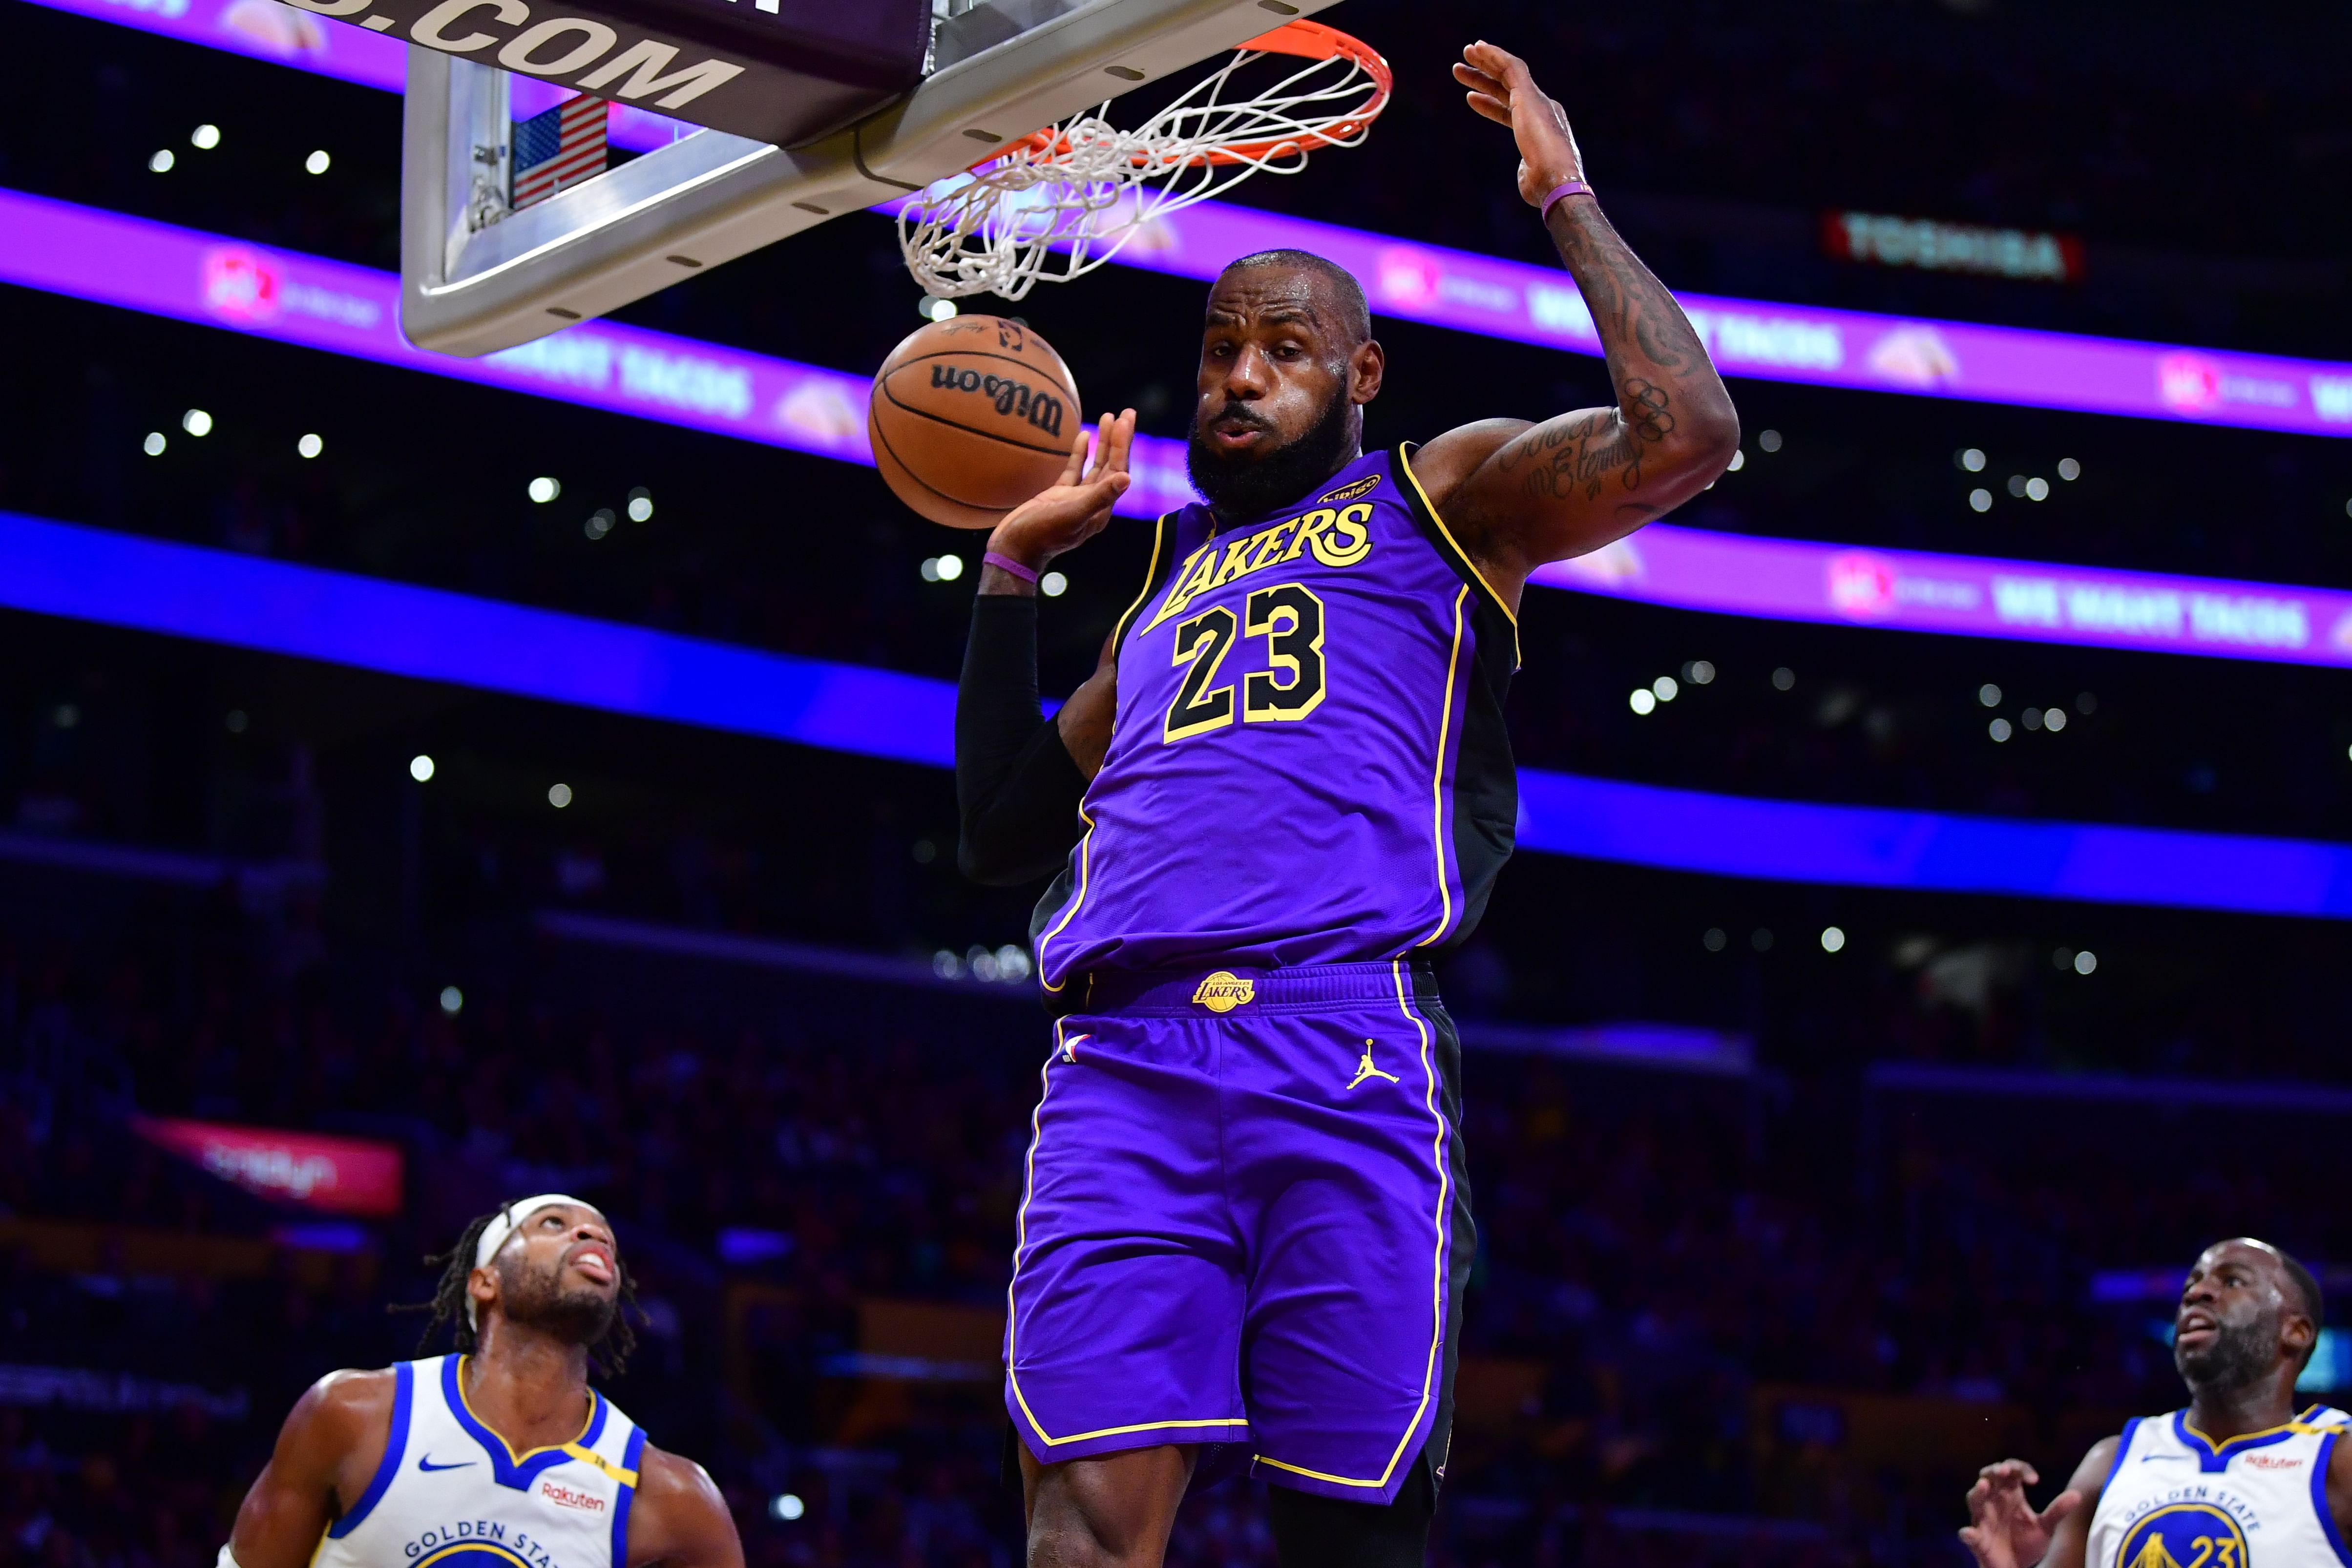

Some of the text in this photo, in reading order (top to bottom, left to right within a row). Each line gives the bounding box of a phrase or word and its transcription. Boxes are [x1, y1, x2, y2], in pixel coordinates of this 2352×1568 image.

[1845, 213, 2064, 279] TOSHIBA
[931, 363, 1063, 437] Wilson
[1138, 502, 1375, 639] LAKERS
[1994, 577, 2059, 626] WE
[2068, 582, 2183, 637] WANT
[2189, 592, 2308, 648] TACOS
[1163, 582, 1326, 745] 23
[1195, 982, 1252, 1002] LAKERS
[2245, 1454, 2303, 1469] Rakuten
[542, 1482, 605, 1512] Rakuten
[2125, 1486, 2261, 1532] GOLDEN STATE
[404, 1520, 559, 1568] GOLDEN STA
[2190, 1535, 2235, 1568] 23
